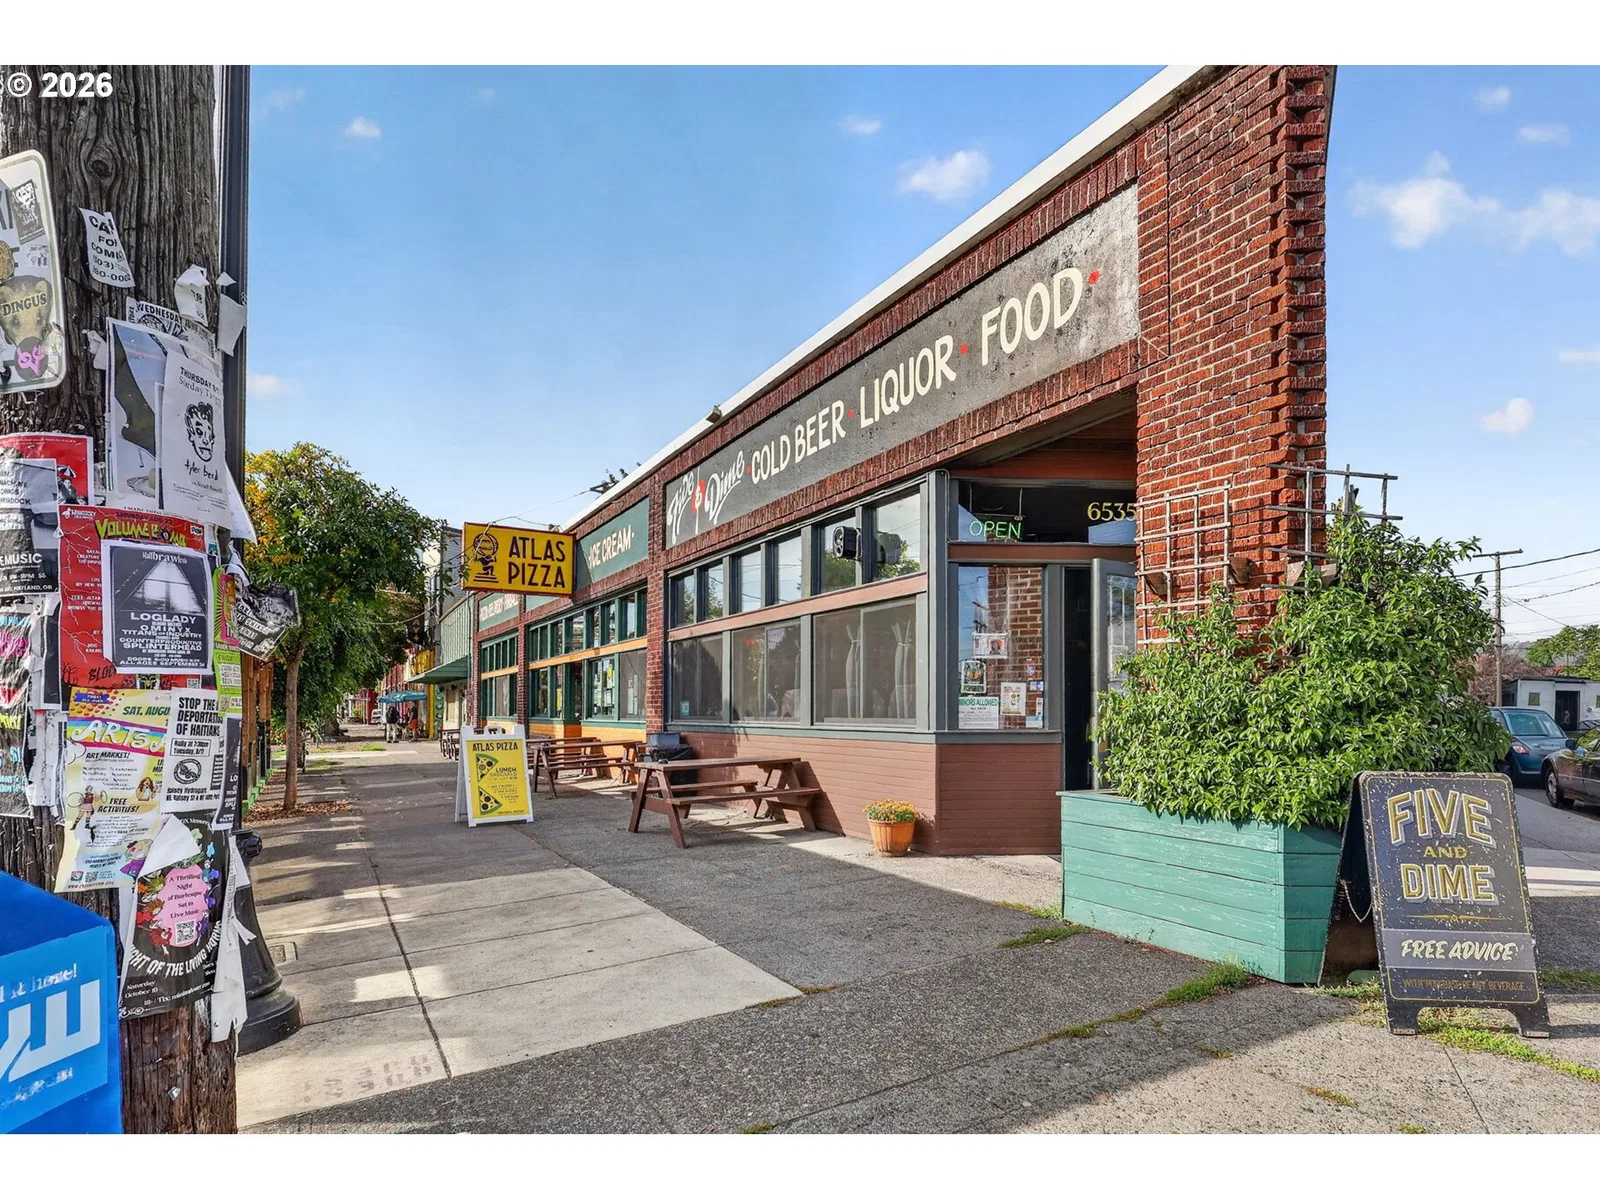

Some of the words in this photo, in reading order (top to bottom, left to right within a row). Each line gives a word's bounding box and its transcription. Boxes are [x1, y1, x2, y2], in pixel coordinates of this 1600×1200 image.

[1, 292, 47, 317] DINGUS
[180, 366, 211, 390] THURSDAY
[751, 434, 791, 485] COLD
[794, 400, 847, 464] BEER
[860, 334, 957, 429] LIQUOR
[982, 267, 1084, 366] FOOD
[704, 450, 745, 526] Dime
[1087, 502, 1137, 522] 6535
[95, 518, 149, 539] VOLUME
[969, 520, 1022, 539] OPEN
[508, 536, 566, 563] ATLAS
[589, 541, 601, 569] ICE
[601, 524, 632, 563] CREAM
[508, 562, 566, 588] PIZZA
[130, 612, 196, 624] LOGLADY
[119, 637, 203, 646] COUNTERPRODUCTIVE
[166, 630, 202, 639] INDUSTRY
[123, 642, 202, 651] SPLINTERHEAD
[178, 696, 201, 711] STOP
[202, 698, 216, 711] THE
[123, 706, 143, 716] SAT.
[175, 723, 188, 736] OF
[472, 742, 495, 752] ATLAS
[496, 742, 518, 751] PIZZA
[100, 751, 130, 759] MARKET!
[97, 805, 139, 813] ACTIVITIES!
[1387, 787, 1496, 849] FIVE
[1423, 846, 1467, 859] AND
[176, 872, 201, 882] Thrilling
[176, 882, 193, 891] Night
[1400, 864, 1499, 905] DIME
[170, 911, 184, 919] Live
[1401, 940, 1448, 959] FREE
[1448, 941, 1517, 961] ADVICE
[147, 956, 166, 975] OF
[165, 962, 184, 978] THE
[185, 948, 207, 973] LIVING
[125, 988, 151, 998] October
[1489, 981, 1525, 991] BEVERAGE
